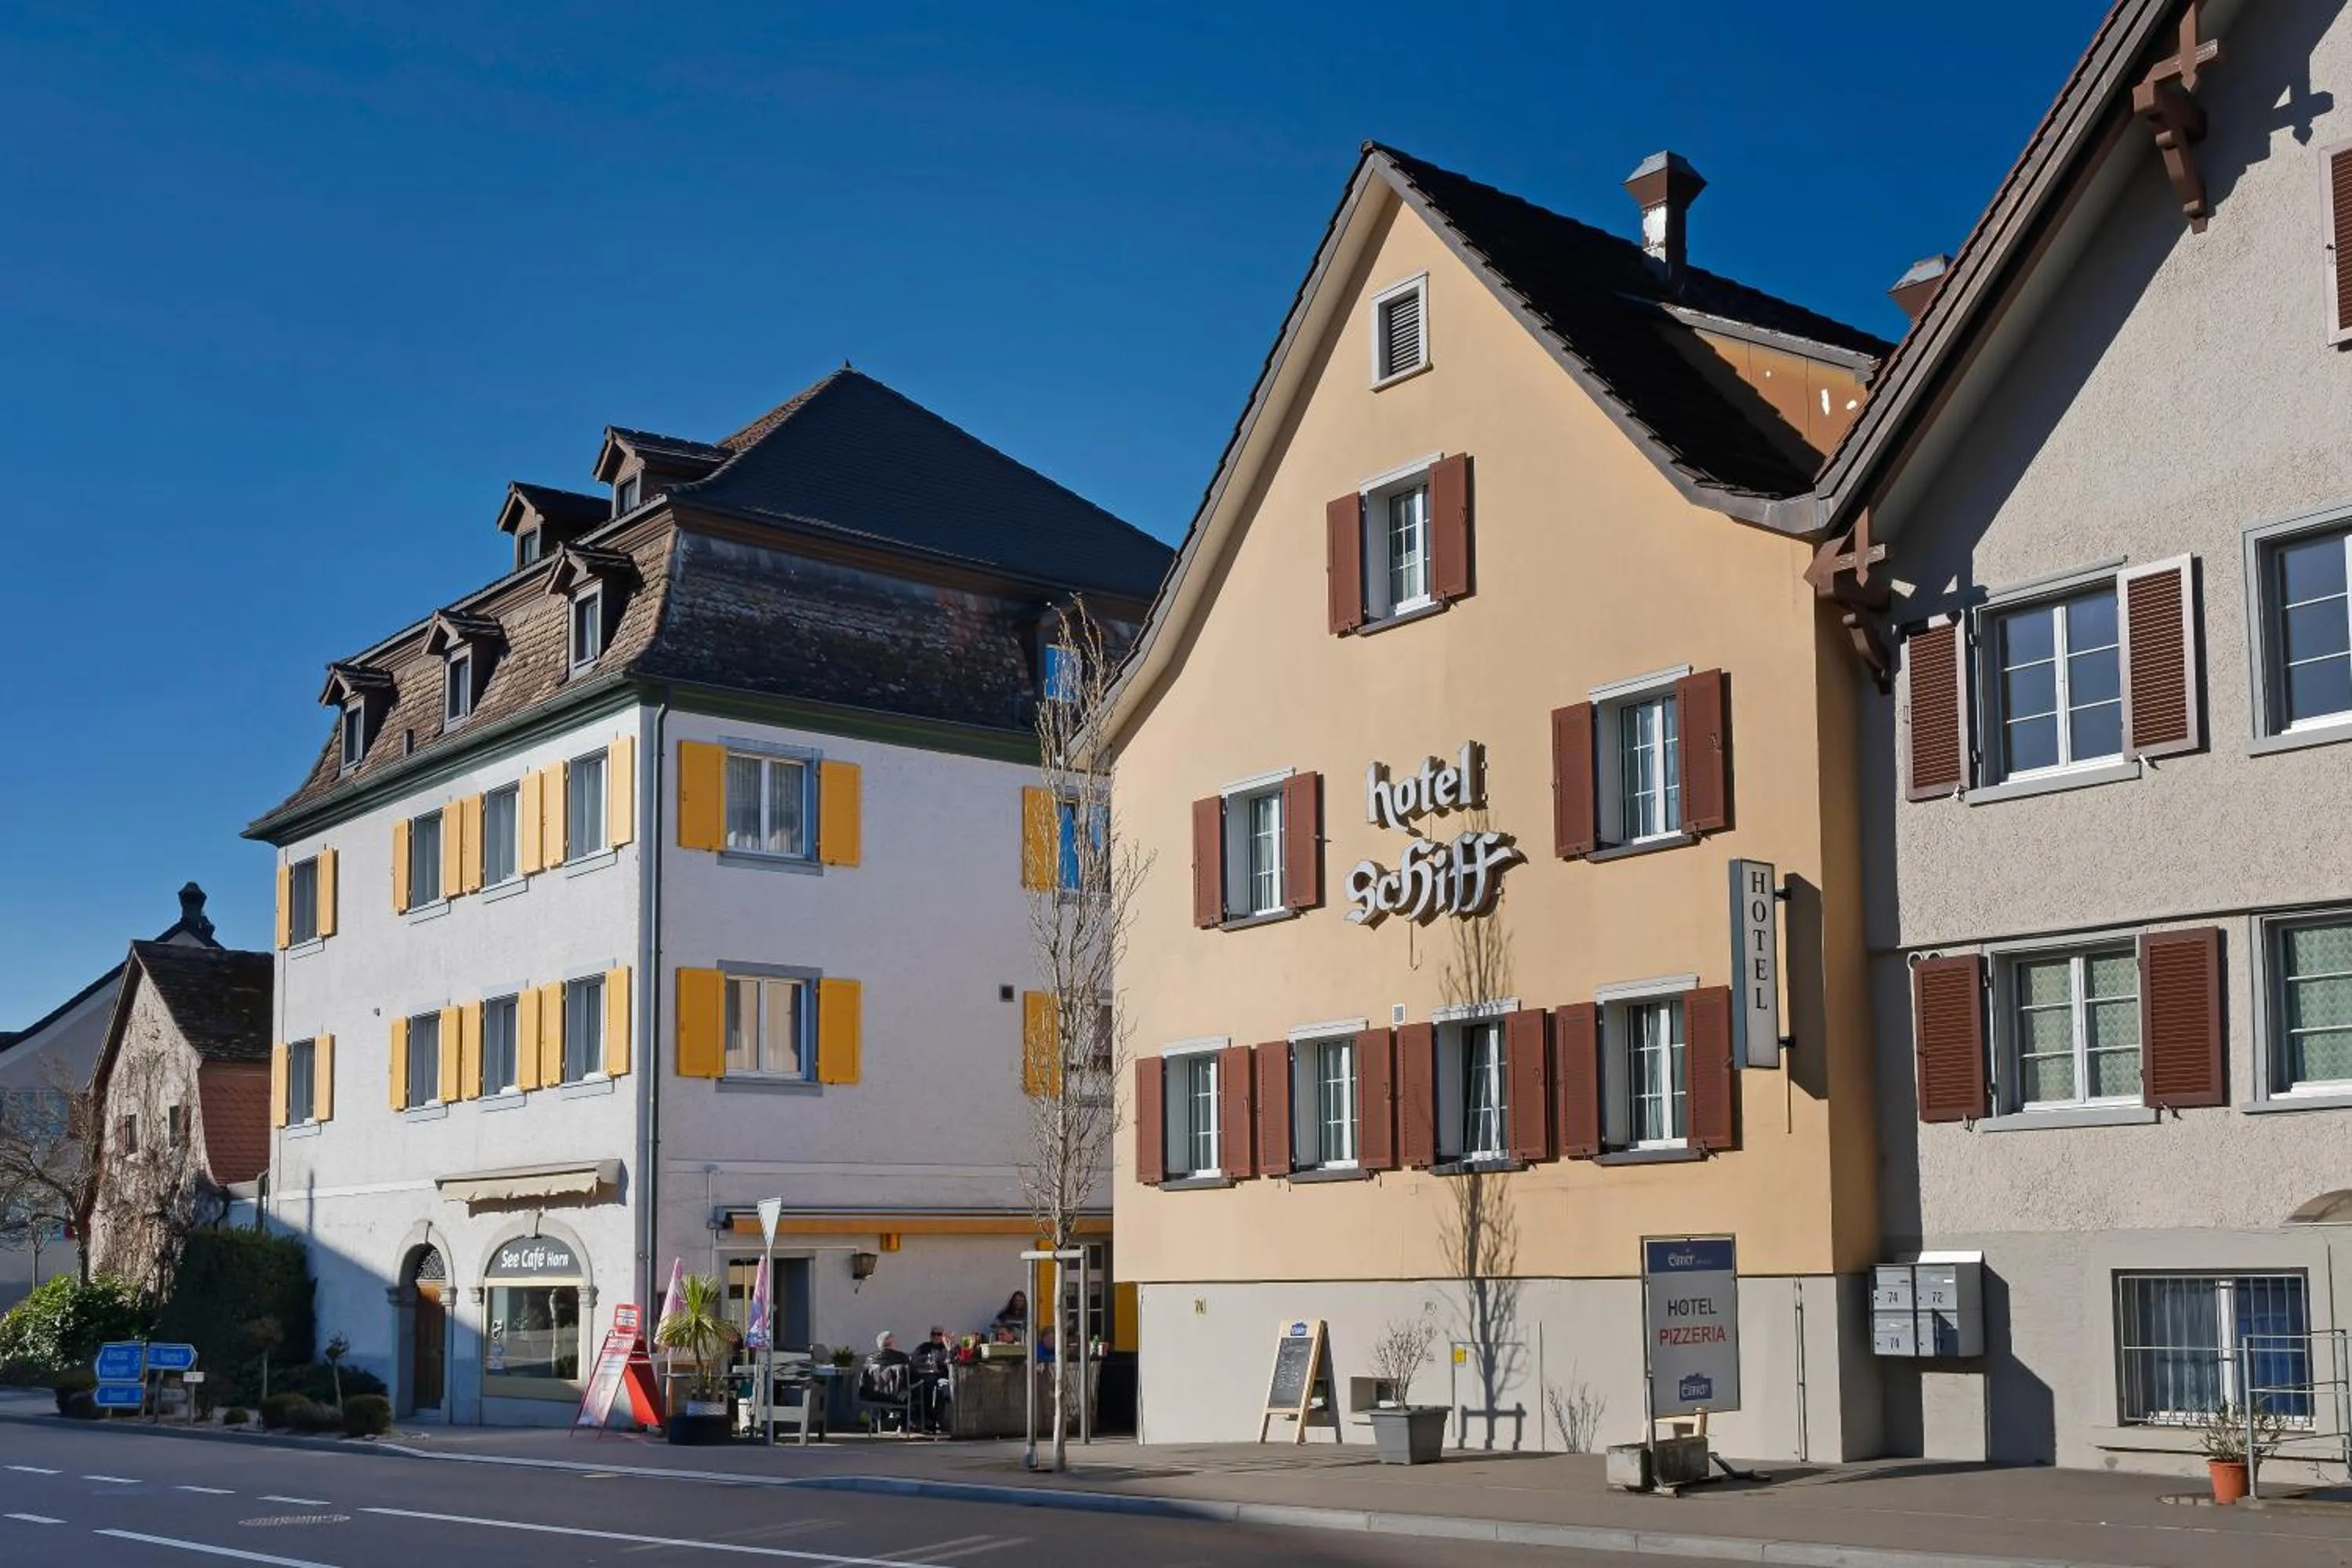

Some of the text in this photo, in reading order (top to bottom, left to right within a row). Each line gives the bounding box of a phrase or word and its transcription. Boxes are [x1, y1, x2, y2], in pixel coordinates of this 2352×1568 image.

[1367, 739, 1480, 833] hotel
[1751, 871, 1768, 1010] HOTEL
[501, 1246, 568, 1271] See Café Horn
[1668, 1298, 1717, 1317] HOTEL
[1932, 1291, 1944, 1303] 72
[1659, 1325, 1726, 1346] PIZZERIA
